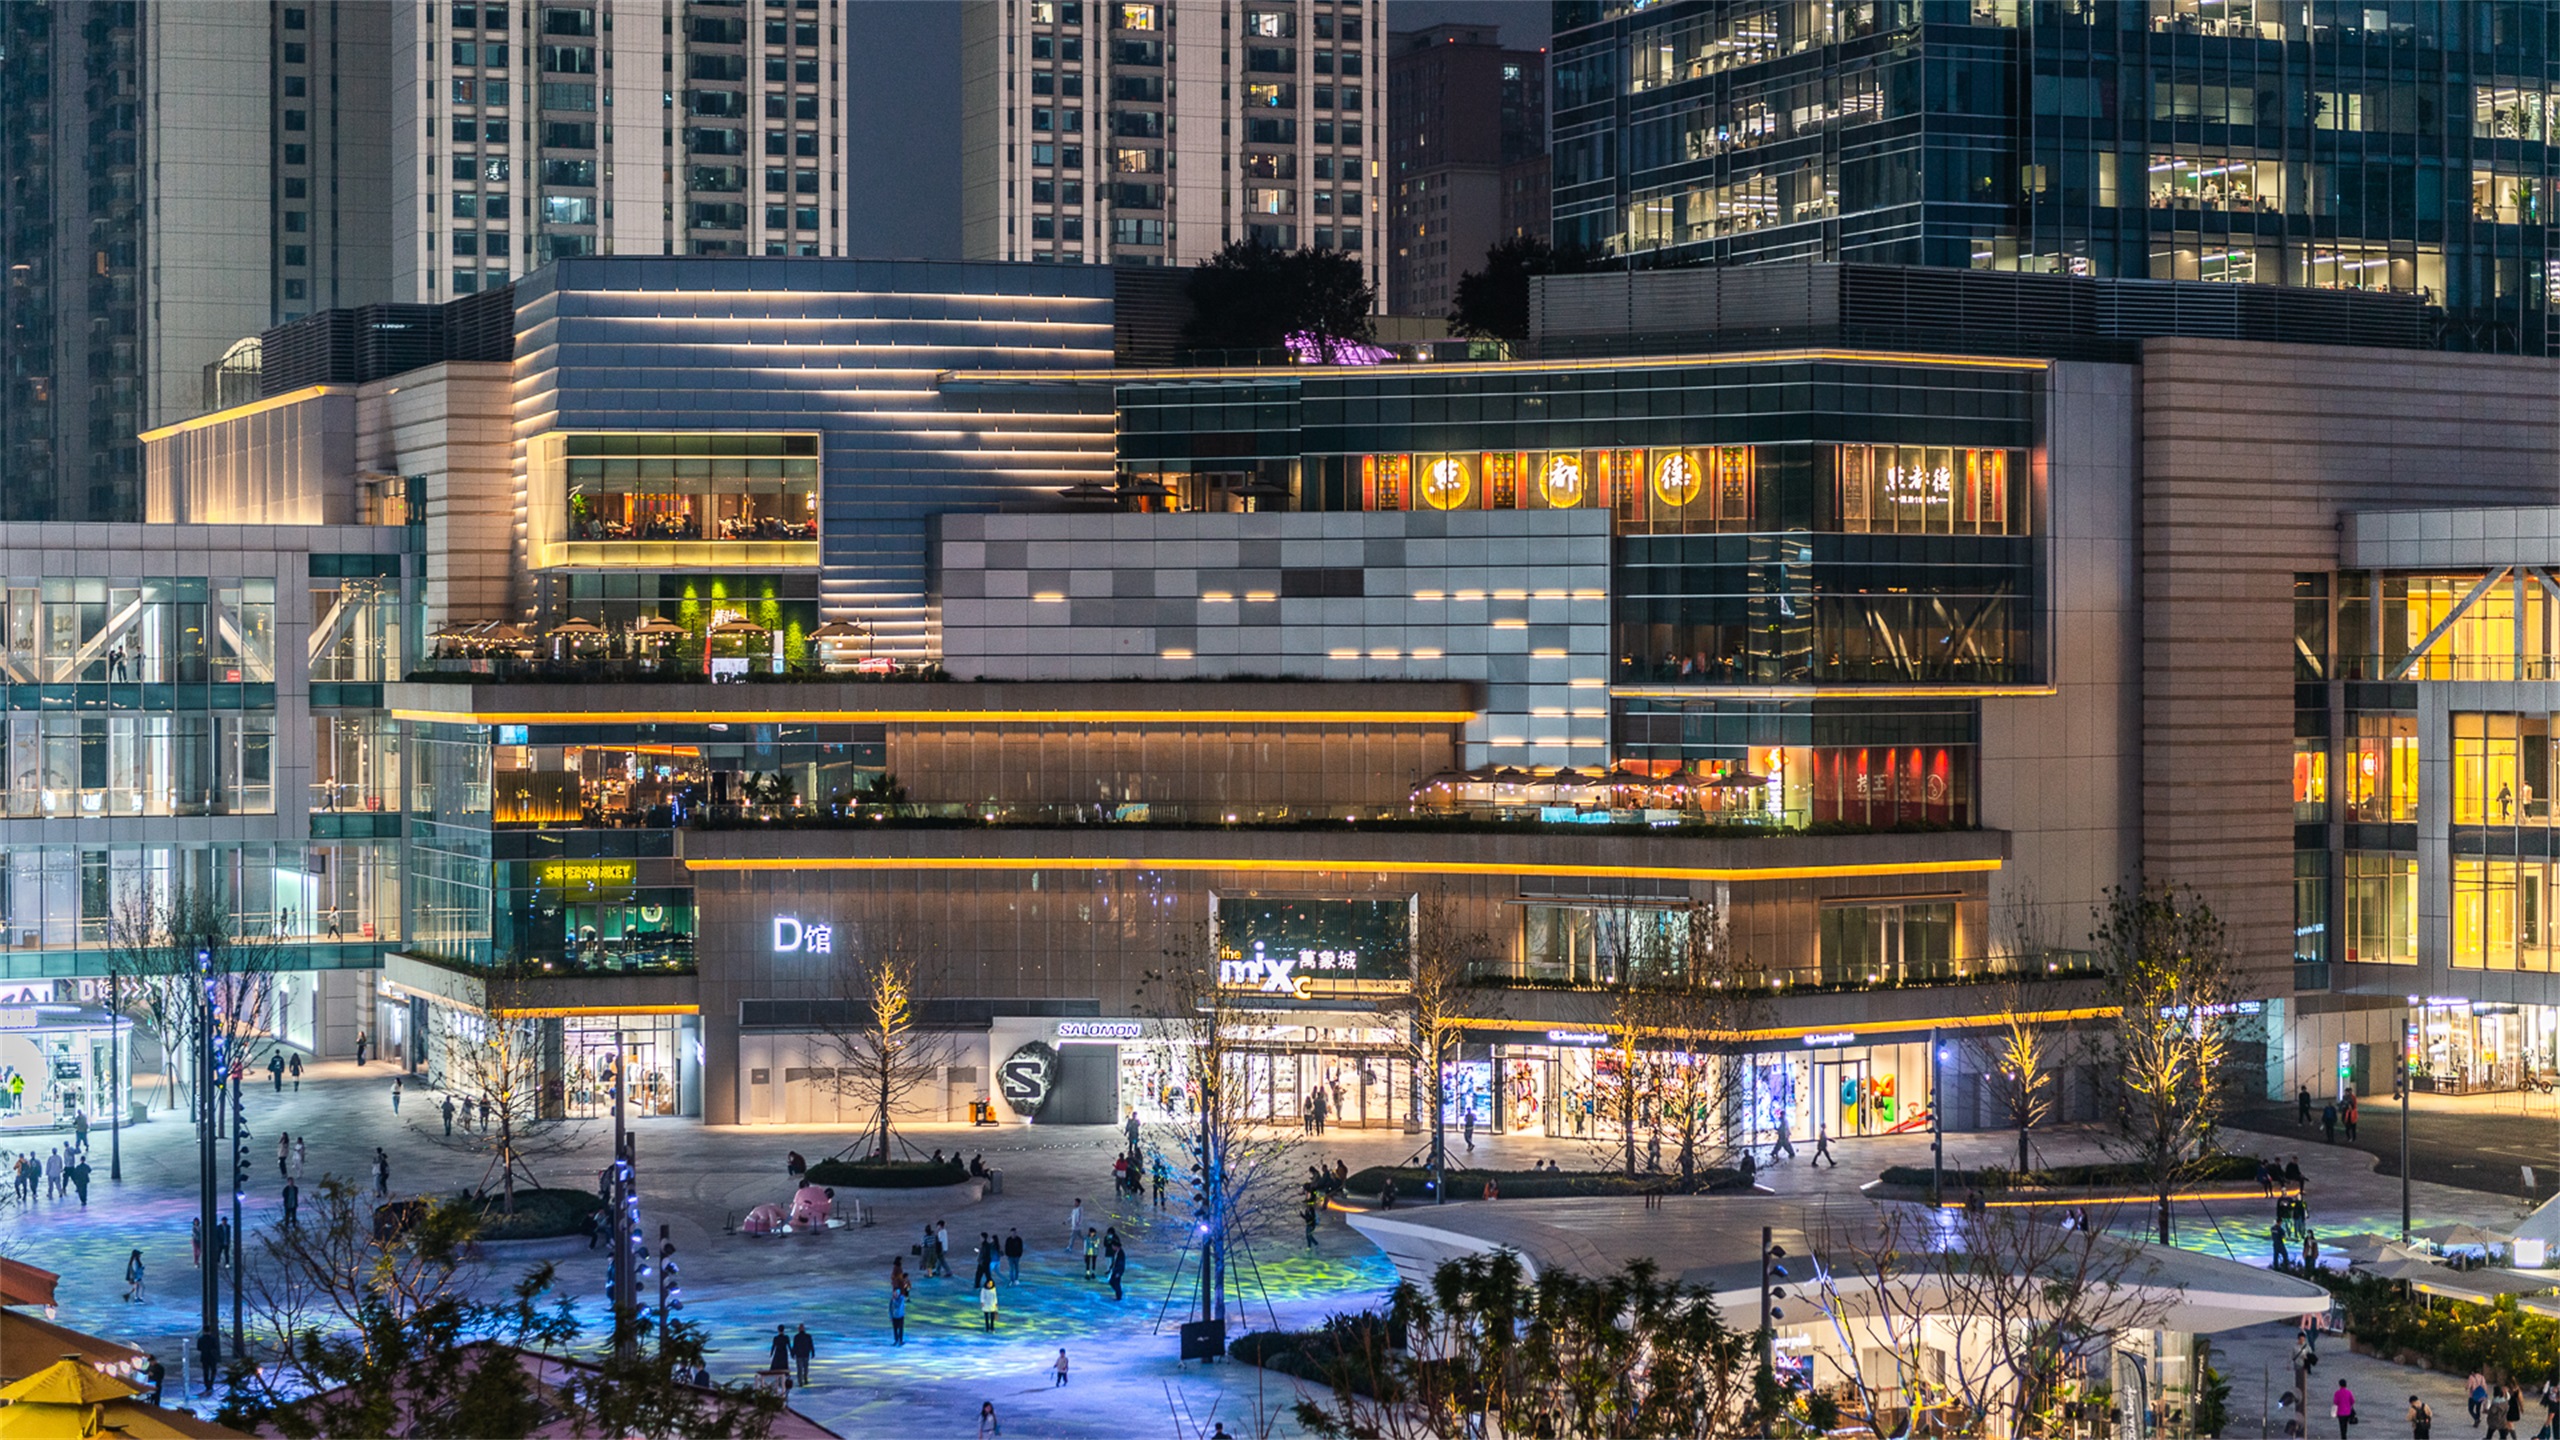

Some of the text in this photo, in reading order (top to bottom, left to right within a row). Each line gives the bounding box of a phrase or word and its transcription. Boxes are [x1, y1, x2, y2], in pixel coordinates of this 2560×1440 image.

[545, 865, 631, 880] SUPERMONKEY
[774, 917, 832, 954] D馆
[1220, 944, 1242, 960] the
[1298, 949, 1357, 970] 萬象城
[1059, 1023, 1141, 1037] SALOMON
[1006, 1062, 1042, 1098] S
